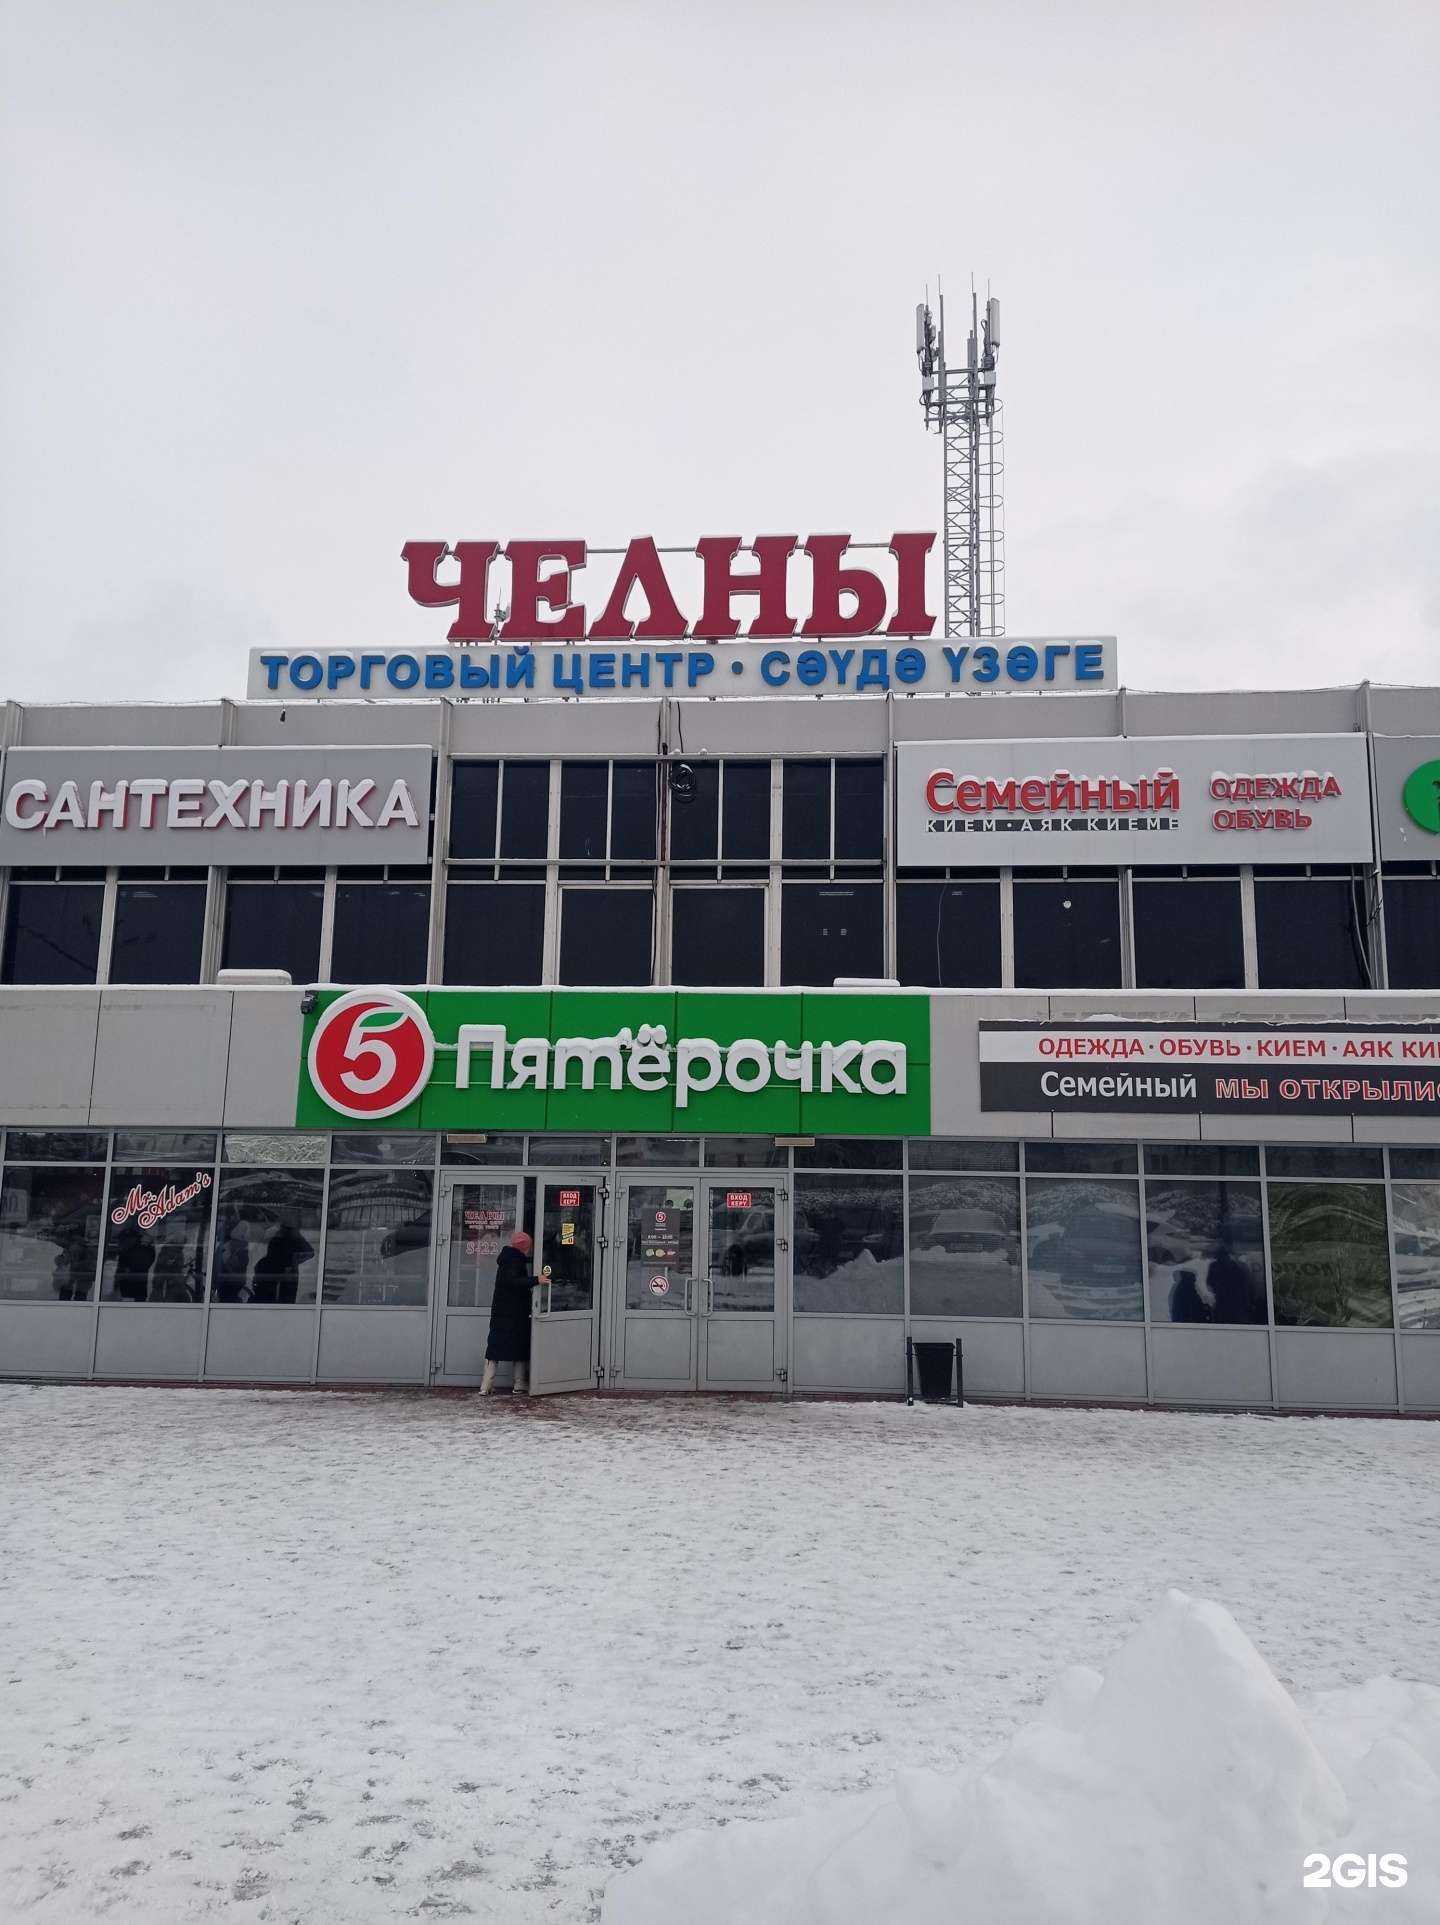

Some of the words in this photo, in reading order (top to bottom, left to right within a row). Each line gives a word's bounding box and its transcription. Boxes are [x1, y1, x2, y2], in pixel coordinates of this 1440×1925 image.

[401, 532, 937, 641] ЧЕЛНЫ
[260, 646, 535, 690] ТОРГОВЫЙ
[553, 652, 715, 695] ЦЕНТР
[761, 648, 926, 691] СӘҮДӘ
[943, 645, 1105, 683] ҮЗӘГЕ
[4, 778, 420, 829] САНТЕХНИКА
[926, 769, 1181, 814] Семейный
[1209, 774, 1342, 802] ОДЕЖДА
[926, 818, 997, 833] КИЕМ
[1021, 818, 1073, 832] АЯК
[1087, 817, 1182, 831] КИЕМЕ
[1213, 807, 1313, 831] ОБУВЬ
[454, 1023, 908, 1108] Пятёрочка
[1038, 1038, 1145, 1059] ОДЕЖДА
[1159, 1039, 1241, 1057] ОБУВЬ
[1257, 1039, 1326, 1057] КИЕМ
[1342, 1040, 1394, 1058] АЯК
[1402, 1041, 1440, 1058] КИ
[1041, 1071, 1197, 1098] Семейный
[1215, 1078, 1269, 1099] МЫ
[1279, 1079, 1440, 1101] ОТКРЫЛИ
[111, 1184, 157, 1224] Mr.
[138, 1172, 211, 1229] Adam's
